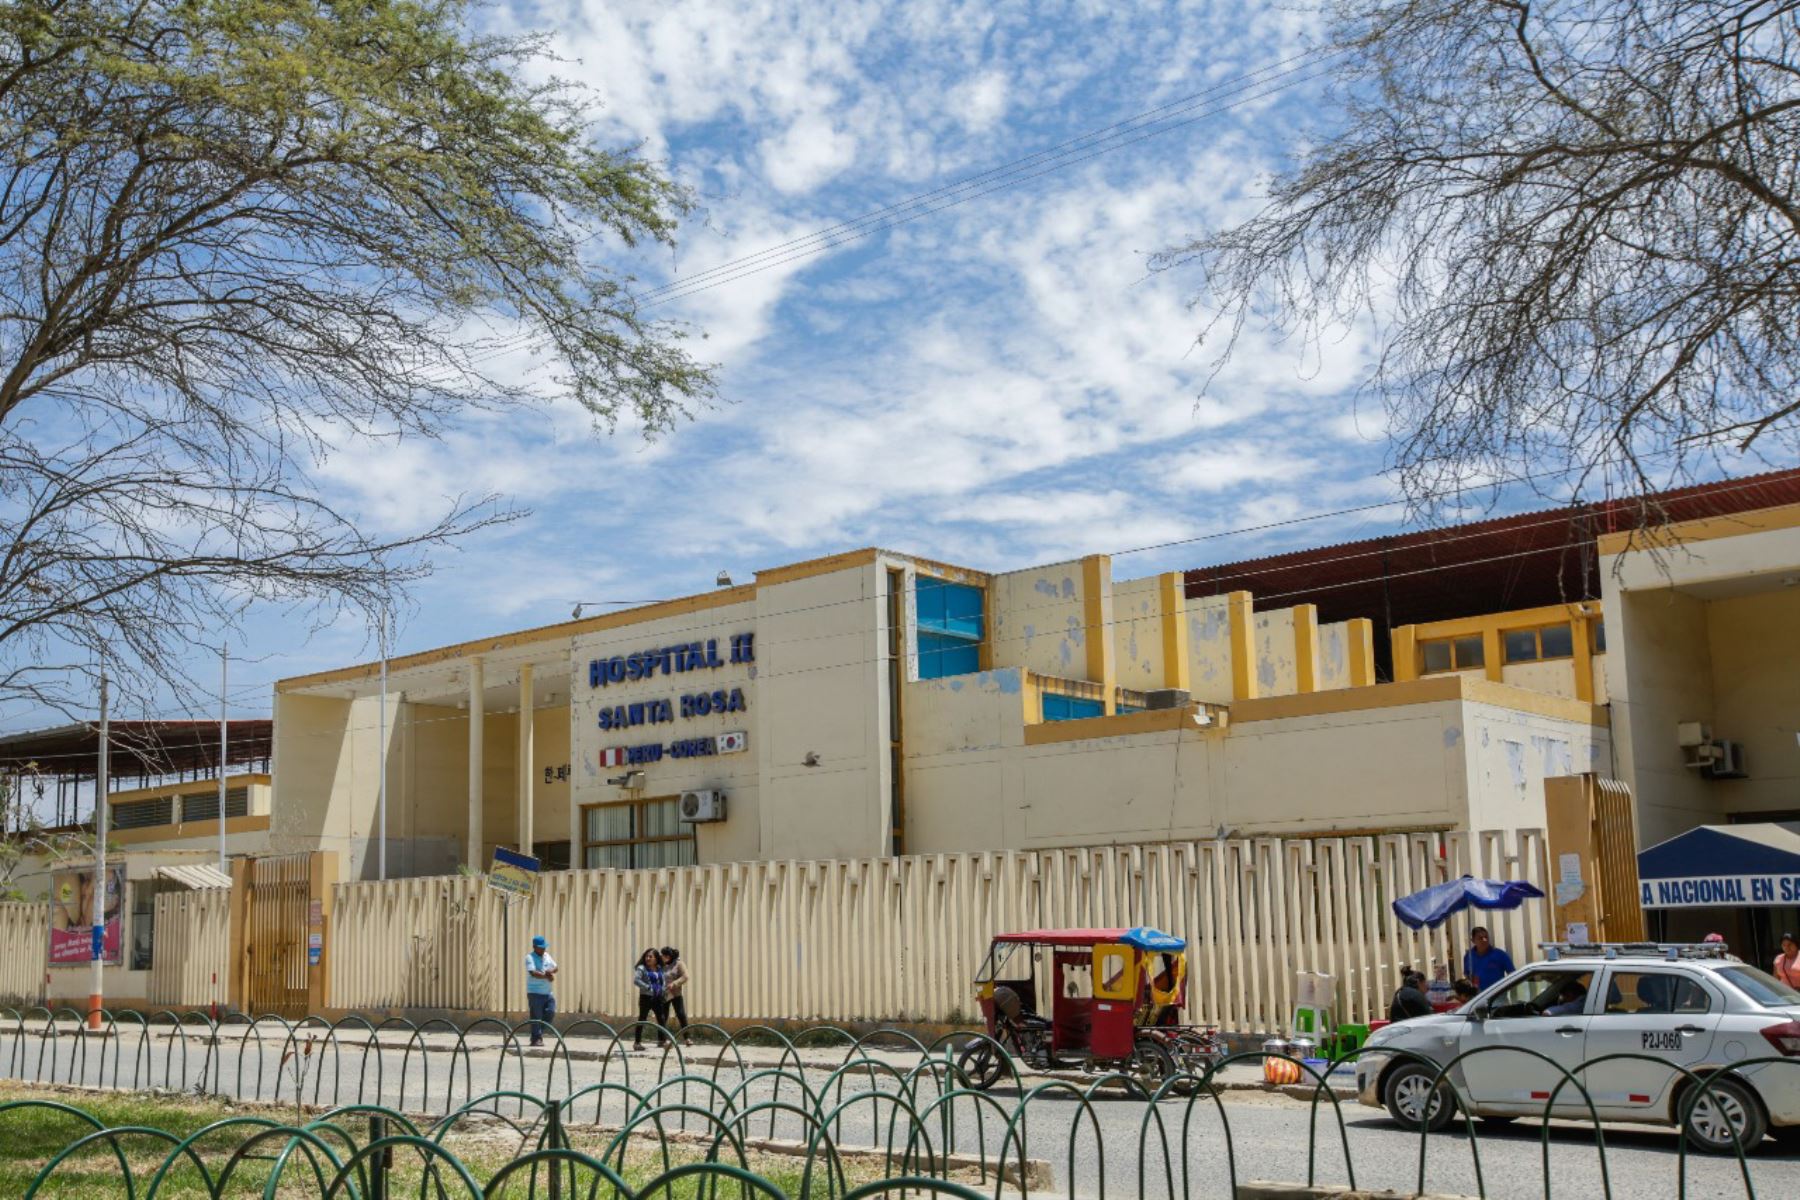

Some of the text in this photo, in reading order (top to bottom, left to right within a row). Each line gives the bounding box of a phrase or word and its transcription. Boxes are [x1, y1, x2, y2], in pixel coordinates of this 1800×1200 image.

[589, 639, 724, 688] HOSPITAL
[598, 688, 746, 730] SANTA ROSA
[1641, 883, 1654, 905] A
[1658, 879, 1745, 904] NACIONAL
[1751, 878, 1774, 901] EN
[1642, 1031, 1681, 1050] P2J-060
